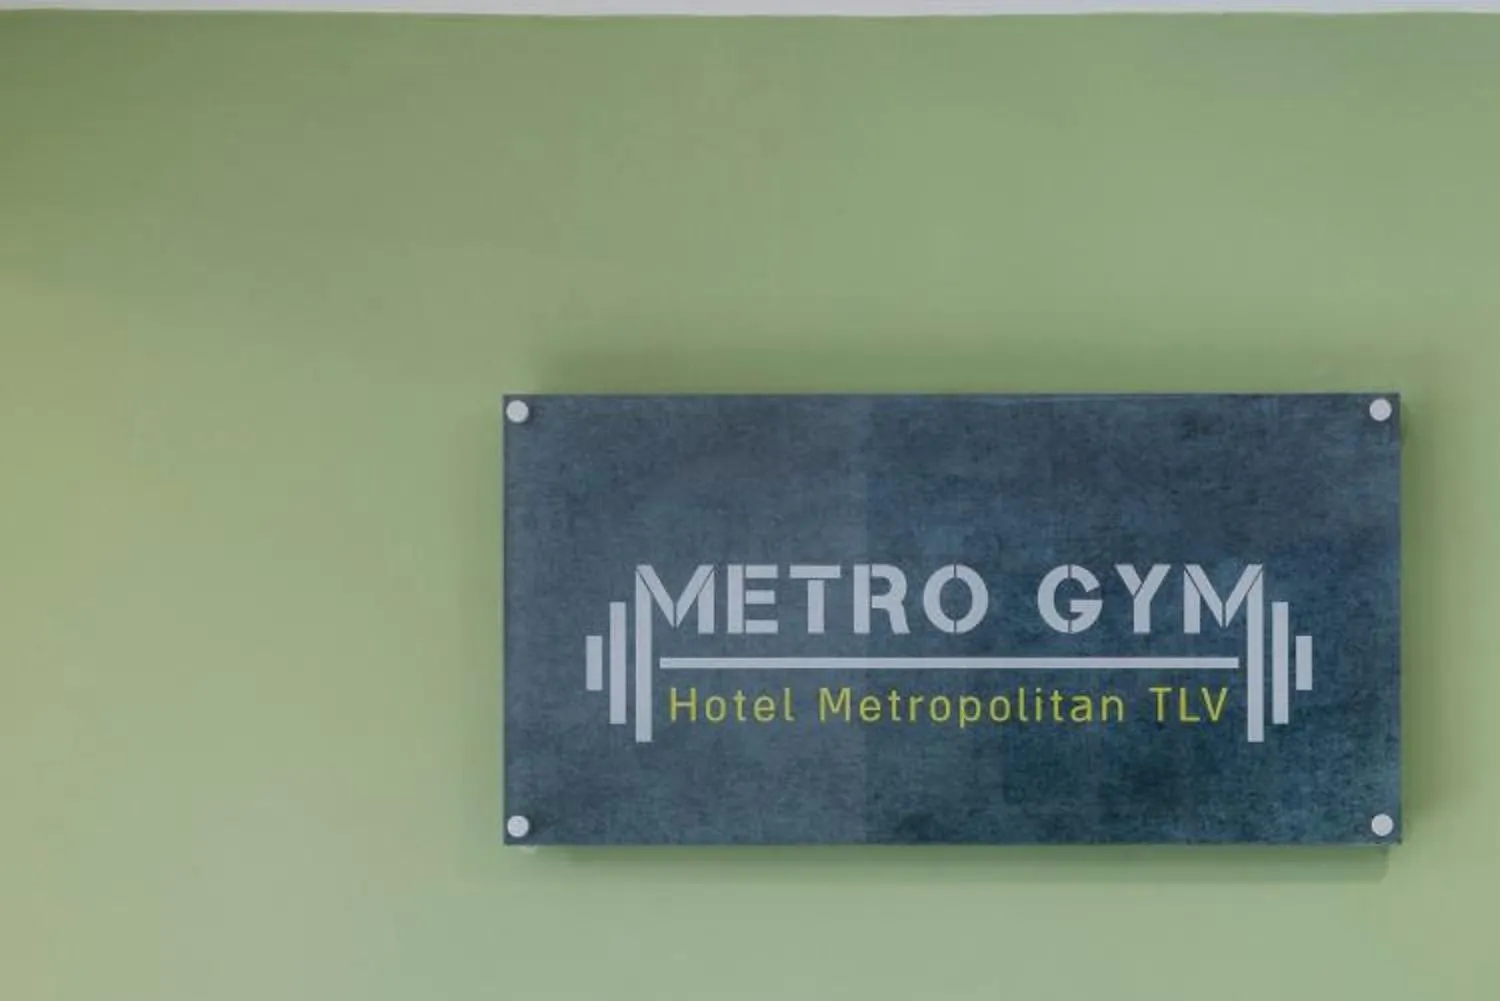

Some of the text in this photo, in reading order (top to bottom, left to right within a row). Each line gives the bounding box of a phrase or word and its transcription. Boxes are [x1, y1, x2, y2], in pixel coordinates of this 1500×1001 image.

[635, 563, 1264, 635] METRO GYM
[669, 686, 1229, 729] Hotel Metropolitan TLV
